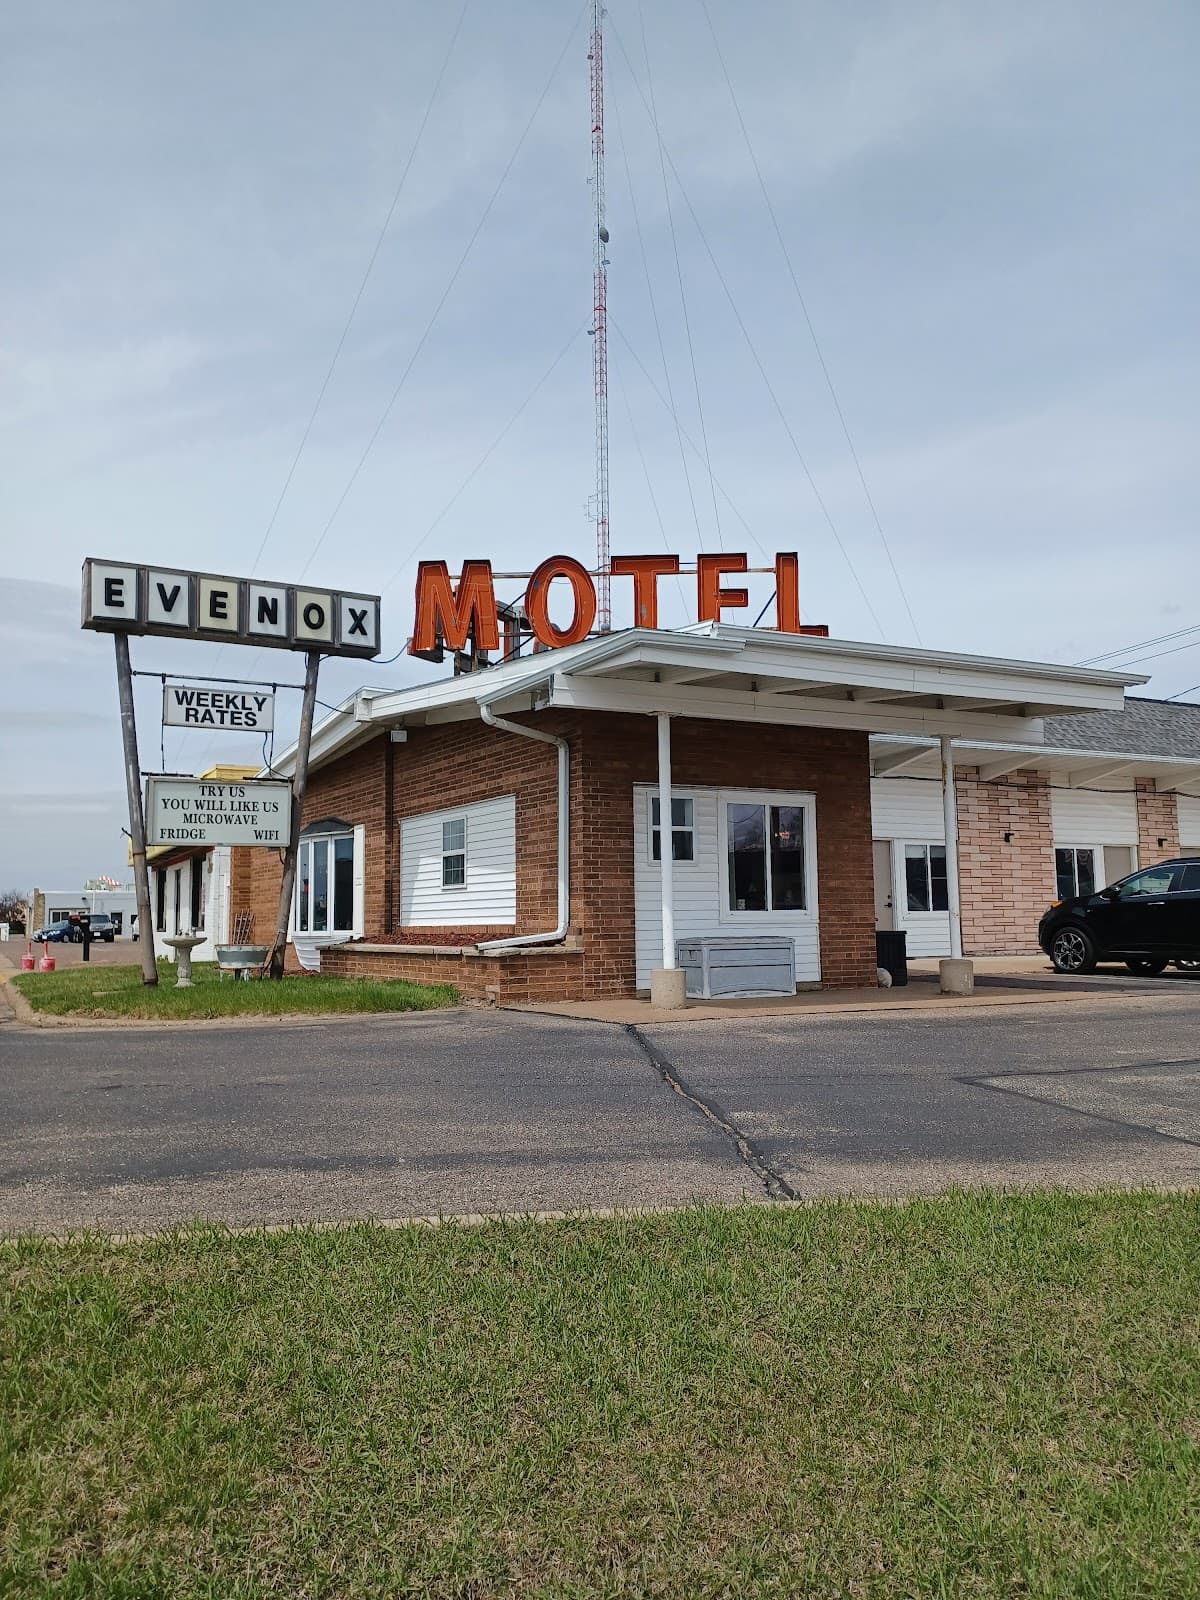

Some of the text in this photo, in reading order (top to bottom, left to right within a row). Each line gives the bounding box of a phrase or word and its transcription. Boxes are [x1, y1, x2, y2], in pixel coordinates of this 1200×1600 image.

[104, 577, 368, 636] EVENOX
[411, 552, 829, 652] MOTEL
[174, 690, 268, 712] WEEKLY
[184, 707, 258, 727] RATES
[199, 785, 246, 798] TRY US
[161, 798, 279, 813] YOU WILL LIKE US
[183, 813, 258, 825] MICROWAVE
[160, 828, 280, 841] FRIDGE WIFI
